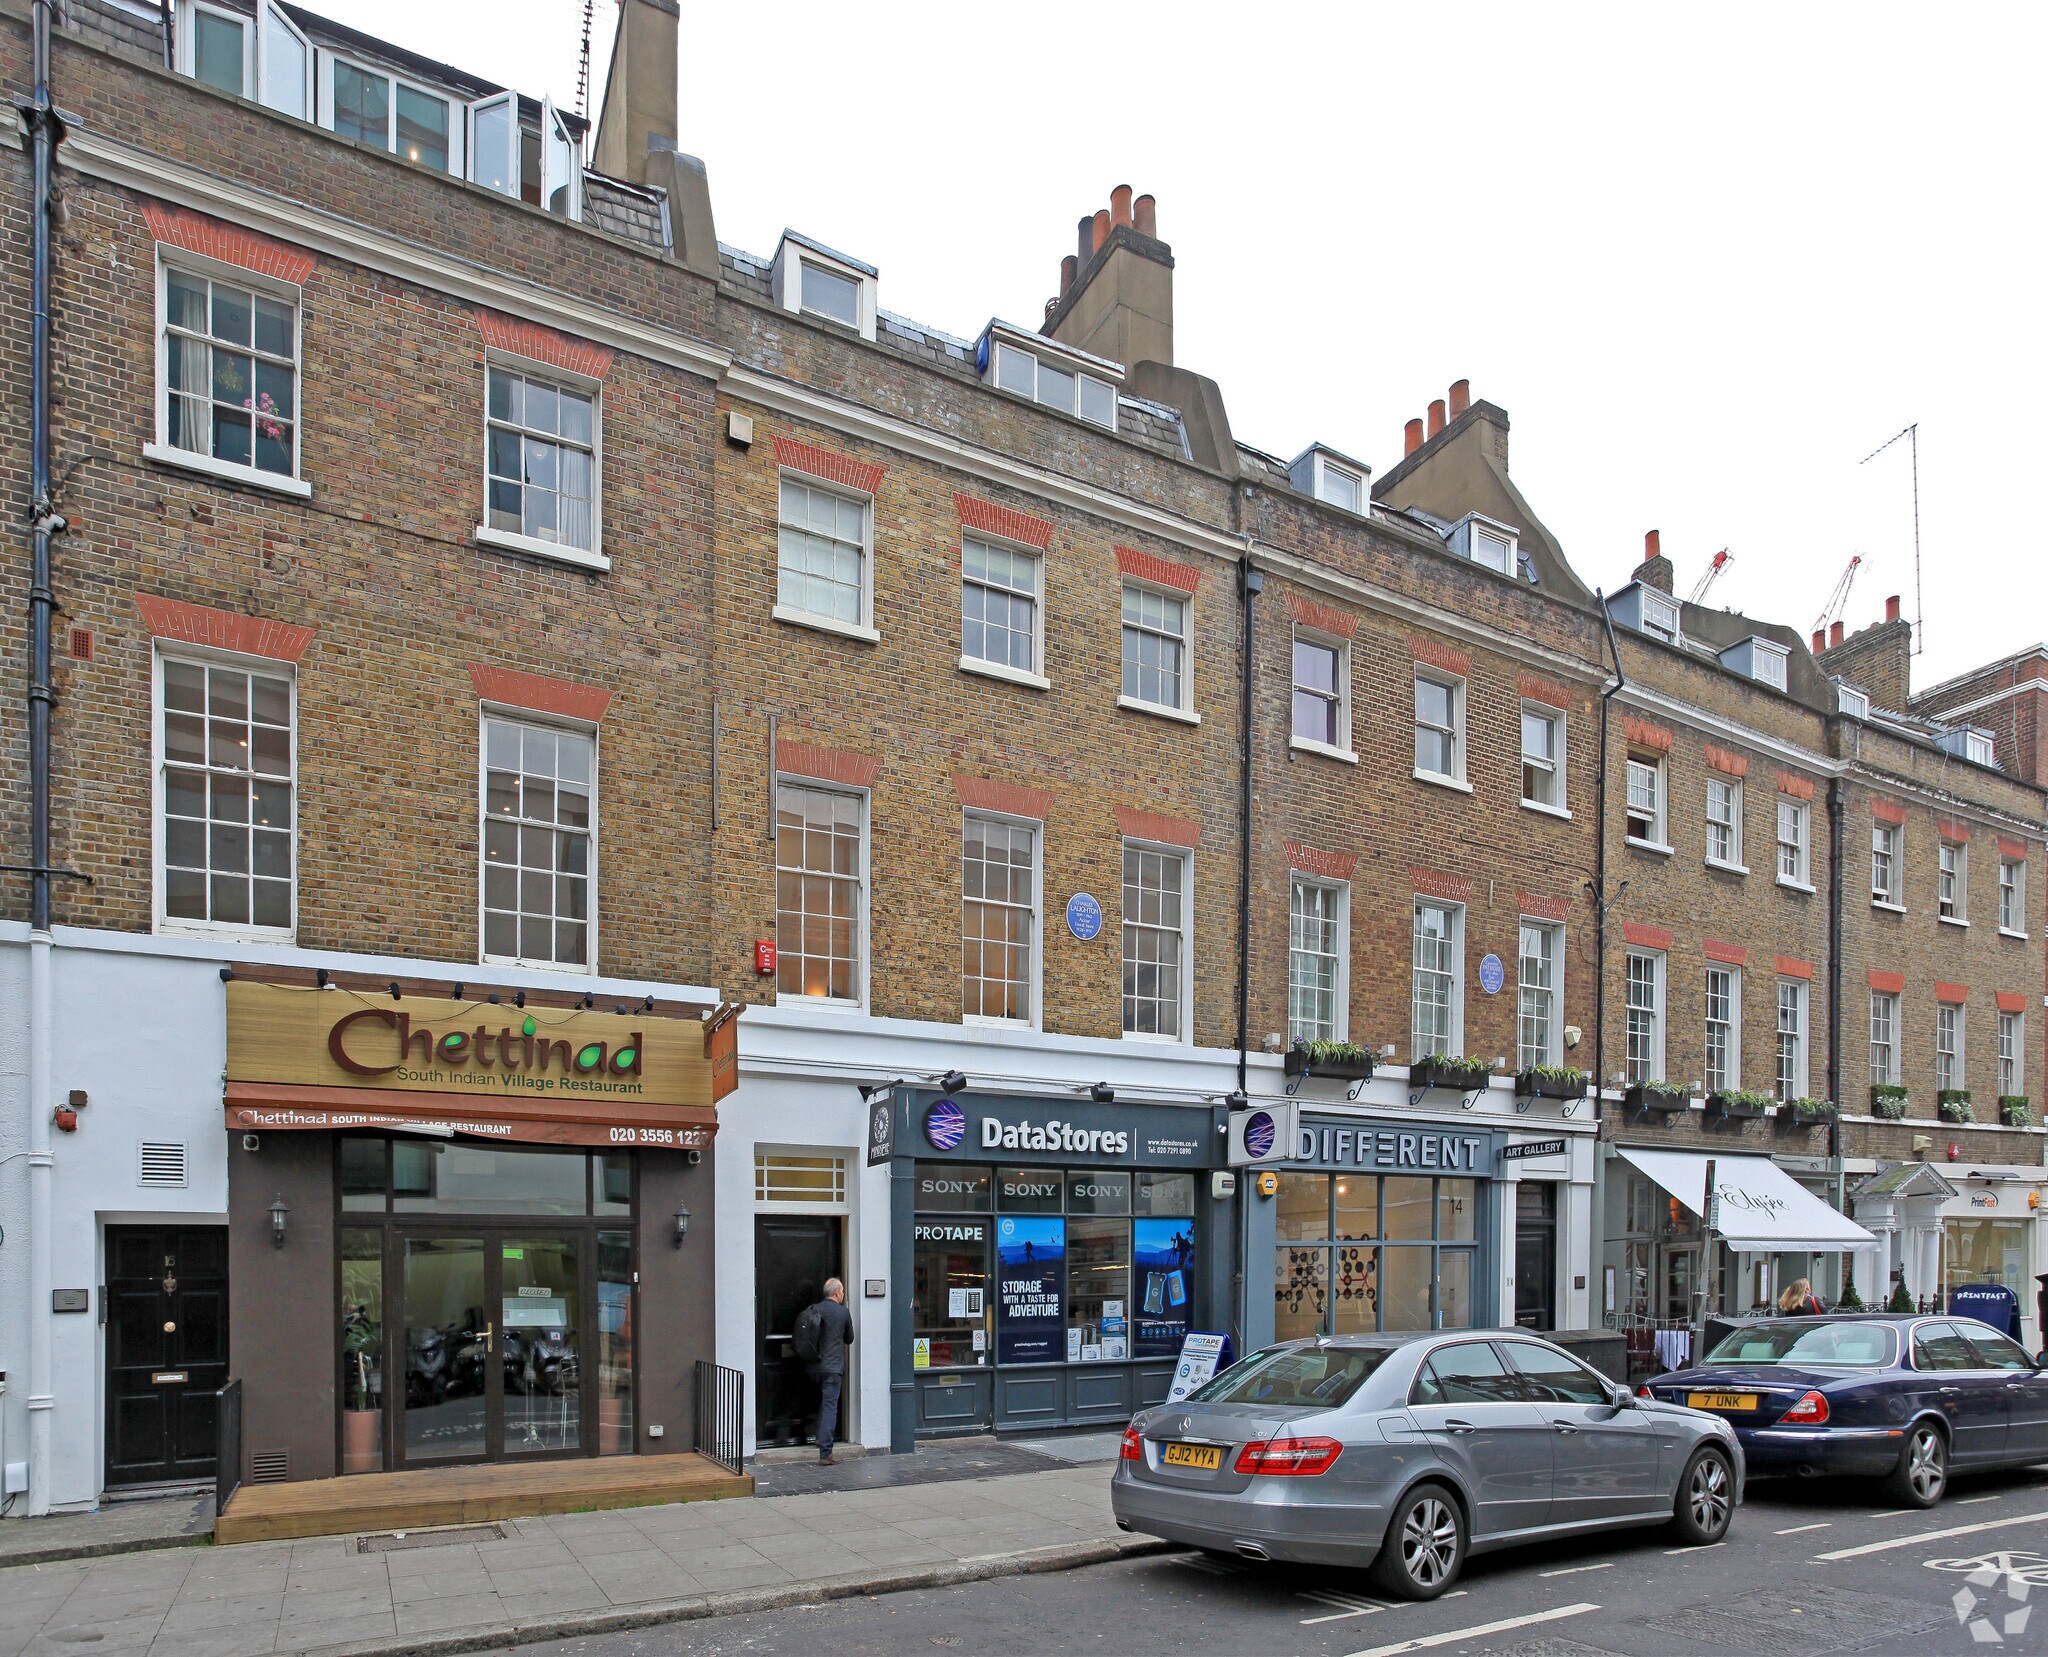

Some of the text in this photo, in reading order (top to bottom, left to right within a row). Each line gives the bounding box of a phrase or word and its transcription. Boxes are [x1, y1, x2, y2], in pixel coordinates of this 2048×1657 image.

[328, 1009, 643, 1077] Chettinad
[397, 1067, 643, 1094] South Indian Village Restaurant
[237, 1109, 327, 1126] Chettinad
[331, 1115, 367, 1124] SOUTH
[450, 1122, 512, 1135] RESTAURANT
[609, 1127, 636, 1142] 020
[640, 1128, 673, 1143] 3556
[980, 1117, 1128, 1154] DataStores
[1297, 1126, 1481, 1169] DIFFERENT
[1505, 1141, 1562, 1158] ART GALLERY
[921, 1179, 978, 1194] SONY
[1003, 1183, 1056, 1197] SONY
[1074, 1184, 1125, 1198] SONY
[1450, 1198, 1463, 1215] 14
[914, 1226, 983, 1241] PROTAPE
[520, 1288, 551, 1297] CLOSED
[1002, 1280, 1042, 1294] STORAGE
[1003, 1293, 1059, 1304] WITH A TASTE FOR
[1008, 1303, 1059, 1317] ADVENTURE
[1188, 1337, 1220, 1346] PROTAPE
[1703, 1395, 1740, 1408] 7 UNK
[1168, 1446, 1214, 1465] GJ12 YYA
